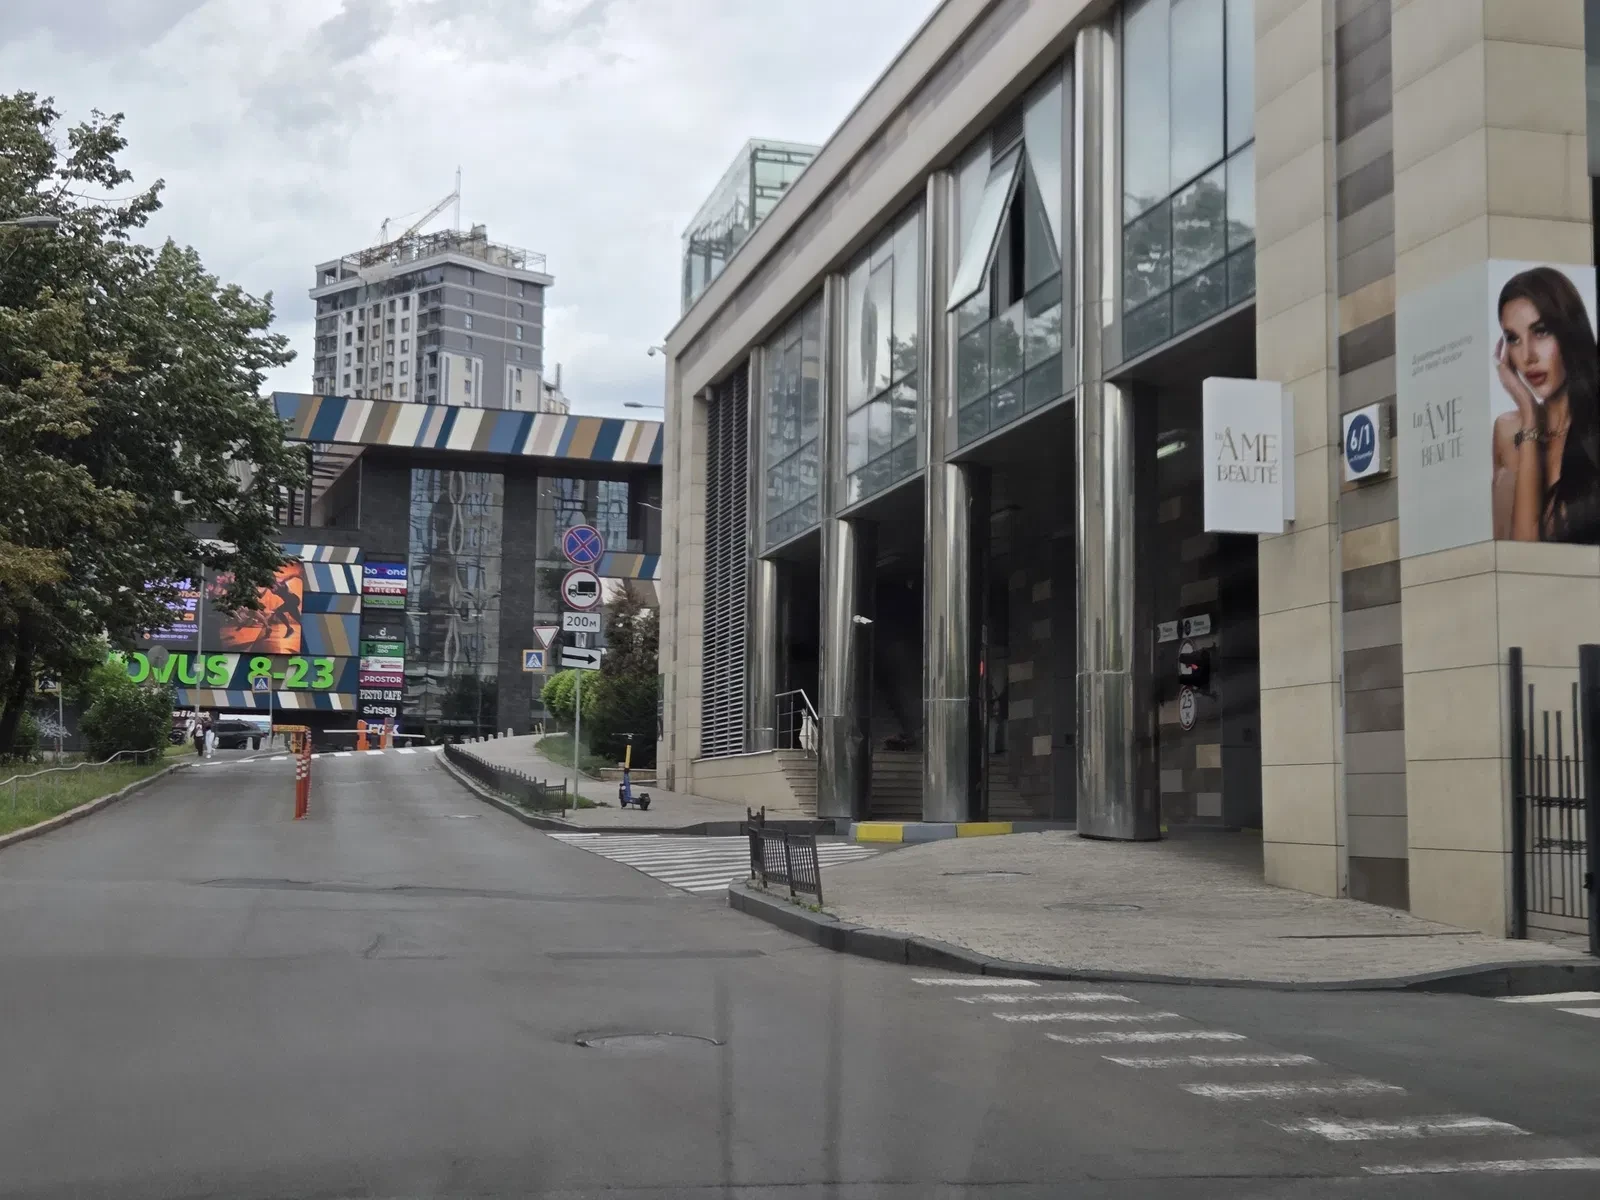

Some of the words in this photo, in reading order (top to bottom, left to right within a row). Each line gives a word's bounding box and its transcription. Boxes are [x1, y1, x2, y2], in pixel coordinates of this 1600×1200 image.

[1350, 423, 1370, 452] 6/1
[368, 587, 402, 595] АПТЕКА
[248, 656, 335, 689] 8-23
[364, 675, 402, 684] PROSTOR
[360, 690, 382, 700] PESTO
[383, 690, 402, 701] CAFE
[363, 704, 397, 718] sinsay
